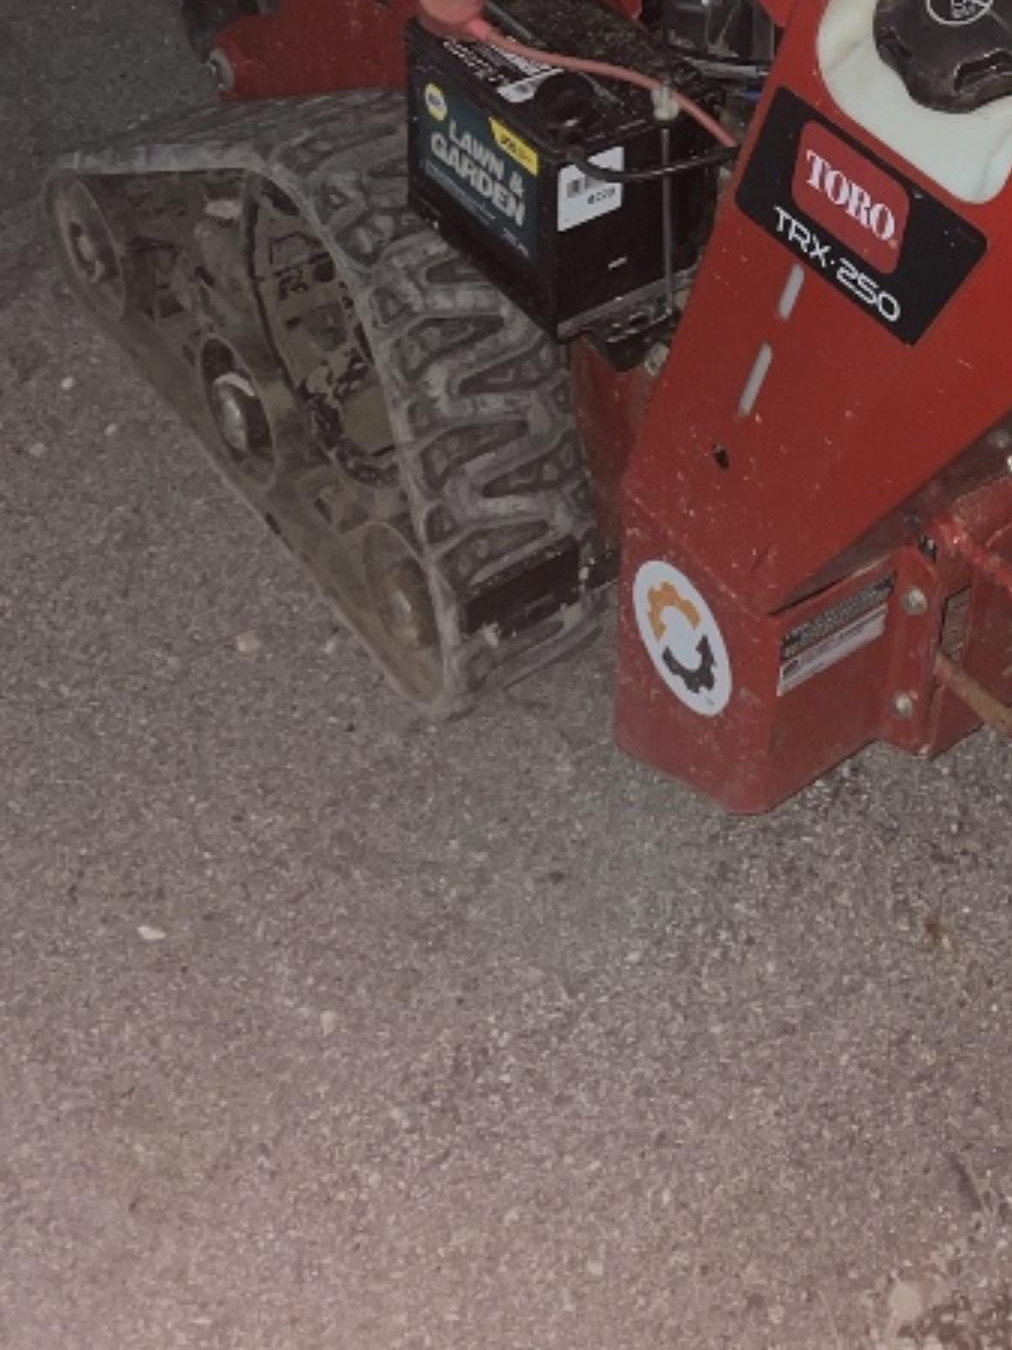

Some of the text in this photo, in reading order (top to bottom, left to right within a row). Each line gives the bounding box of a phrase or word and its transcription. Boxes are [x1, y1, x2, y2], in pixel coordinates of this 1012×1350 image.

[431, 132, 526, 227] GARDEN
[451, 119, 504, 180] LAWN
[509, 171, 525, 199] &
[806, 149, 896, 240] TORO
